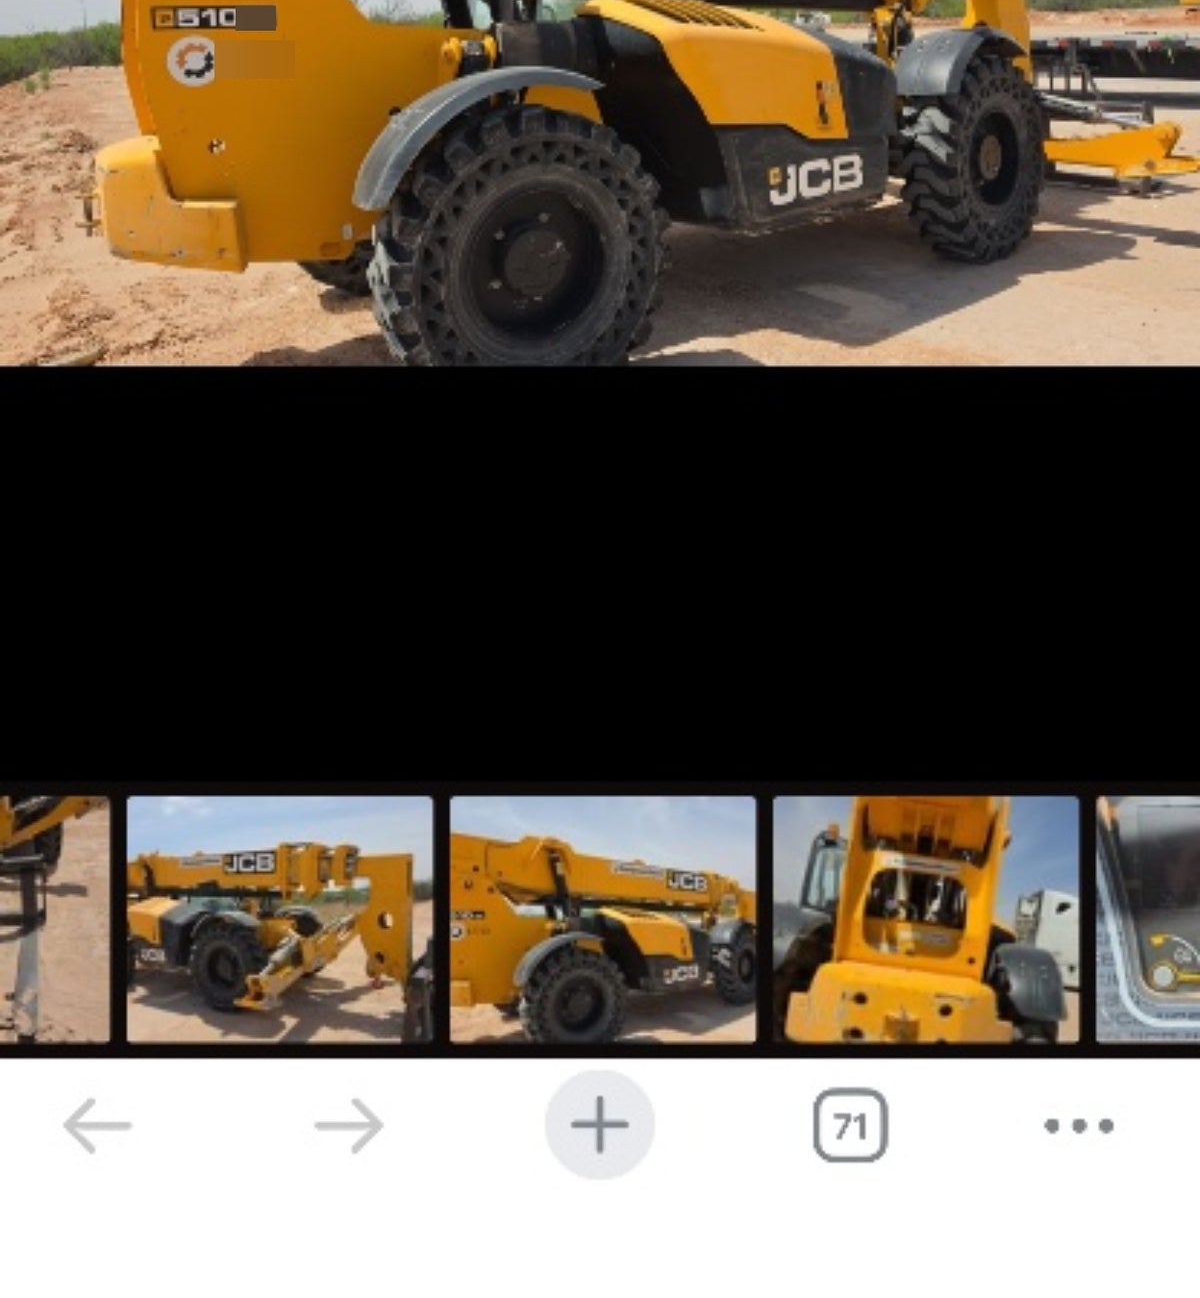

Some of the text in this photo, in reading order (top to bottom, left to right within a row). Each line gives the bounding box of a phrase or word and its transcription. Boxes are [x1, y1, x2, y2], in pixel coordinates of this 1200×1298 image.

[769, 154, 863, 205] JCB
[224, 852, 275, 873] JCB
[669, 873, 708, 891] JCB
[833, 1112, 867, 1140] 71
